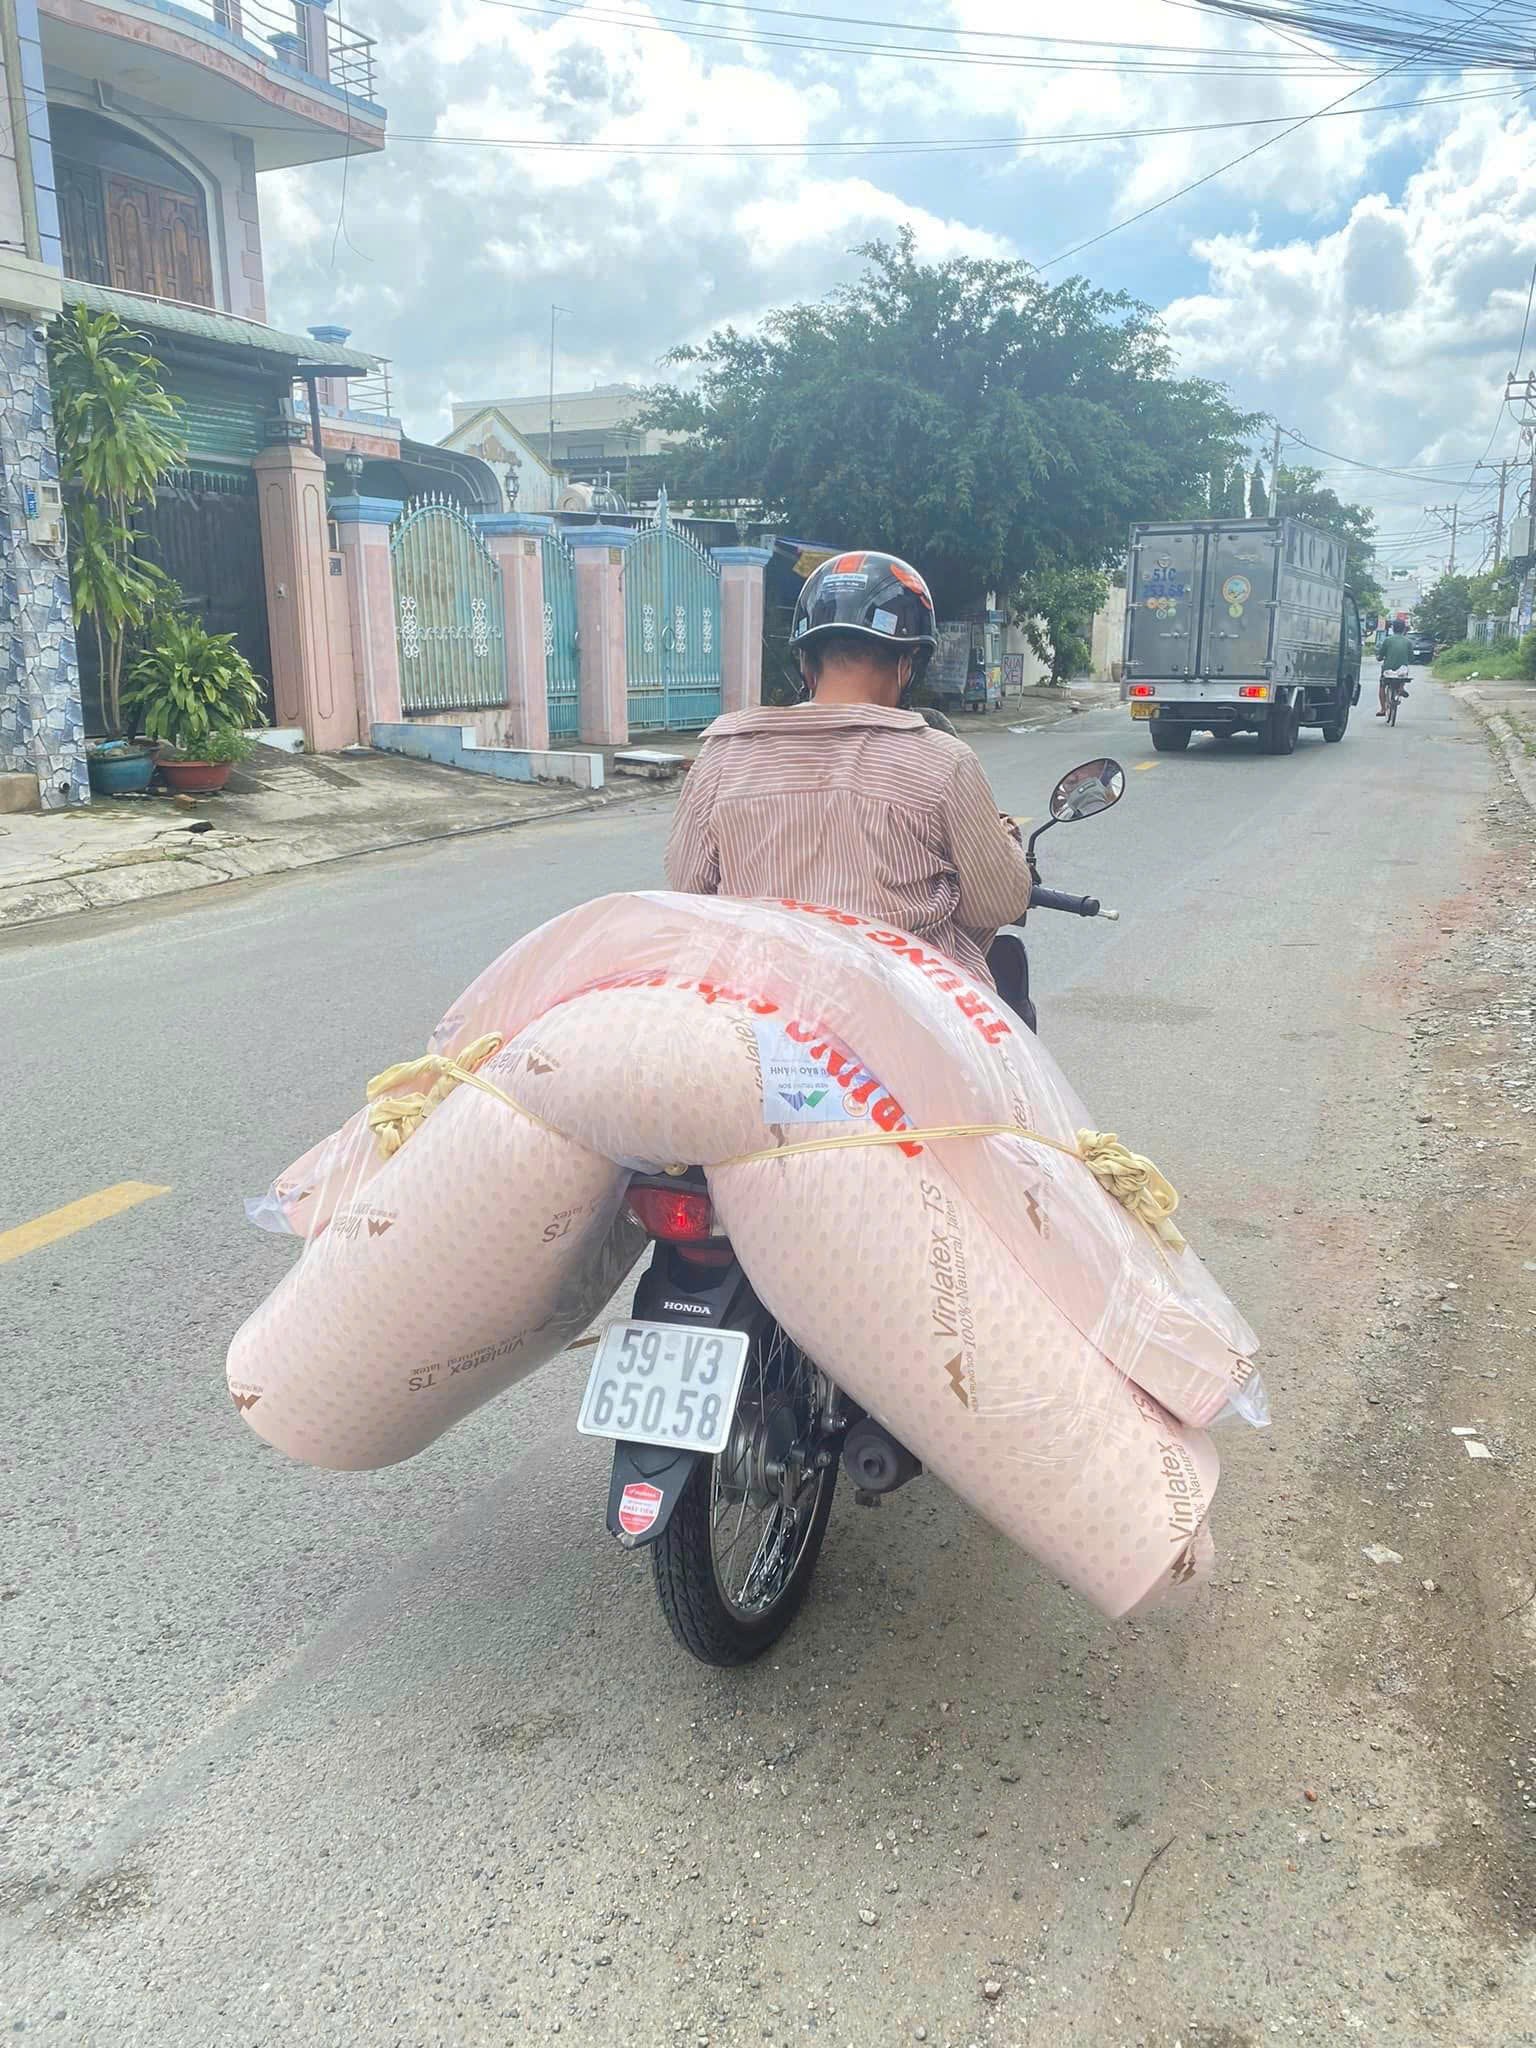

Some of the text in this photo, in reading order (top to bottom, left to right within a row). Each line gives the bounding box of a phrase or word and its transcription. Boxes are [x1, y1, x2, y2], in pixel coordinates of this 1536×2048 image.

[865, 930, 1012, 1045] TRUNG
[542, 1219, 572, 1243] TS
[920, 1180, 959, 1336] Vinlatex TS
[948, 1234, 969, 1302] Nautural
[663, 1301, 712, 1316] HONDA
[957, 1305, 977, 1350] 100%
[408, 1338, 525, 1392] Vinlatex TS
[616, 1328, 723, 1385] 59-V3
[593, 1379, 721, 1441] 650.58
[1156, 1439, 1194, 1542] Vinlatex
